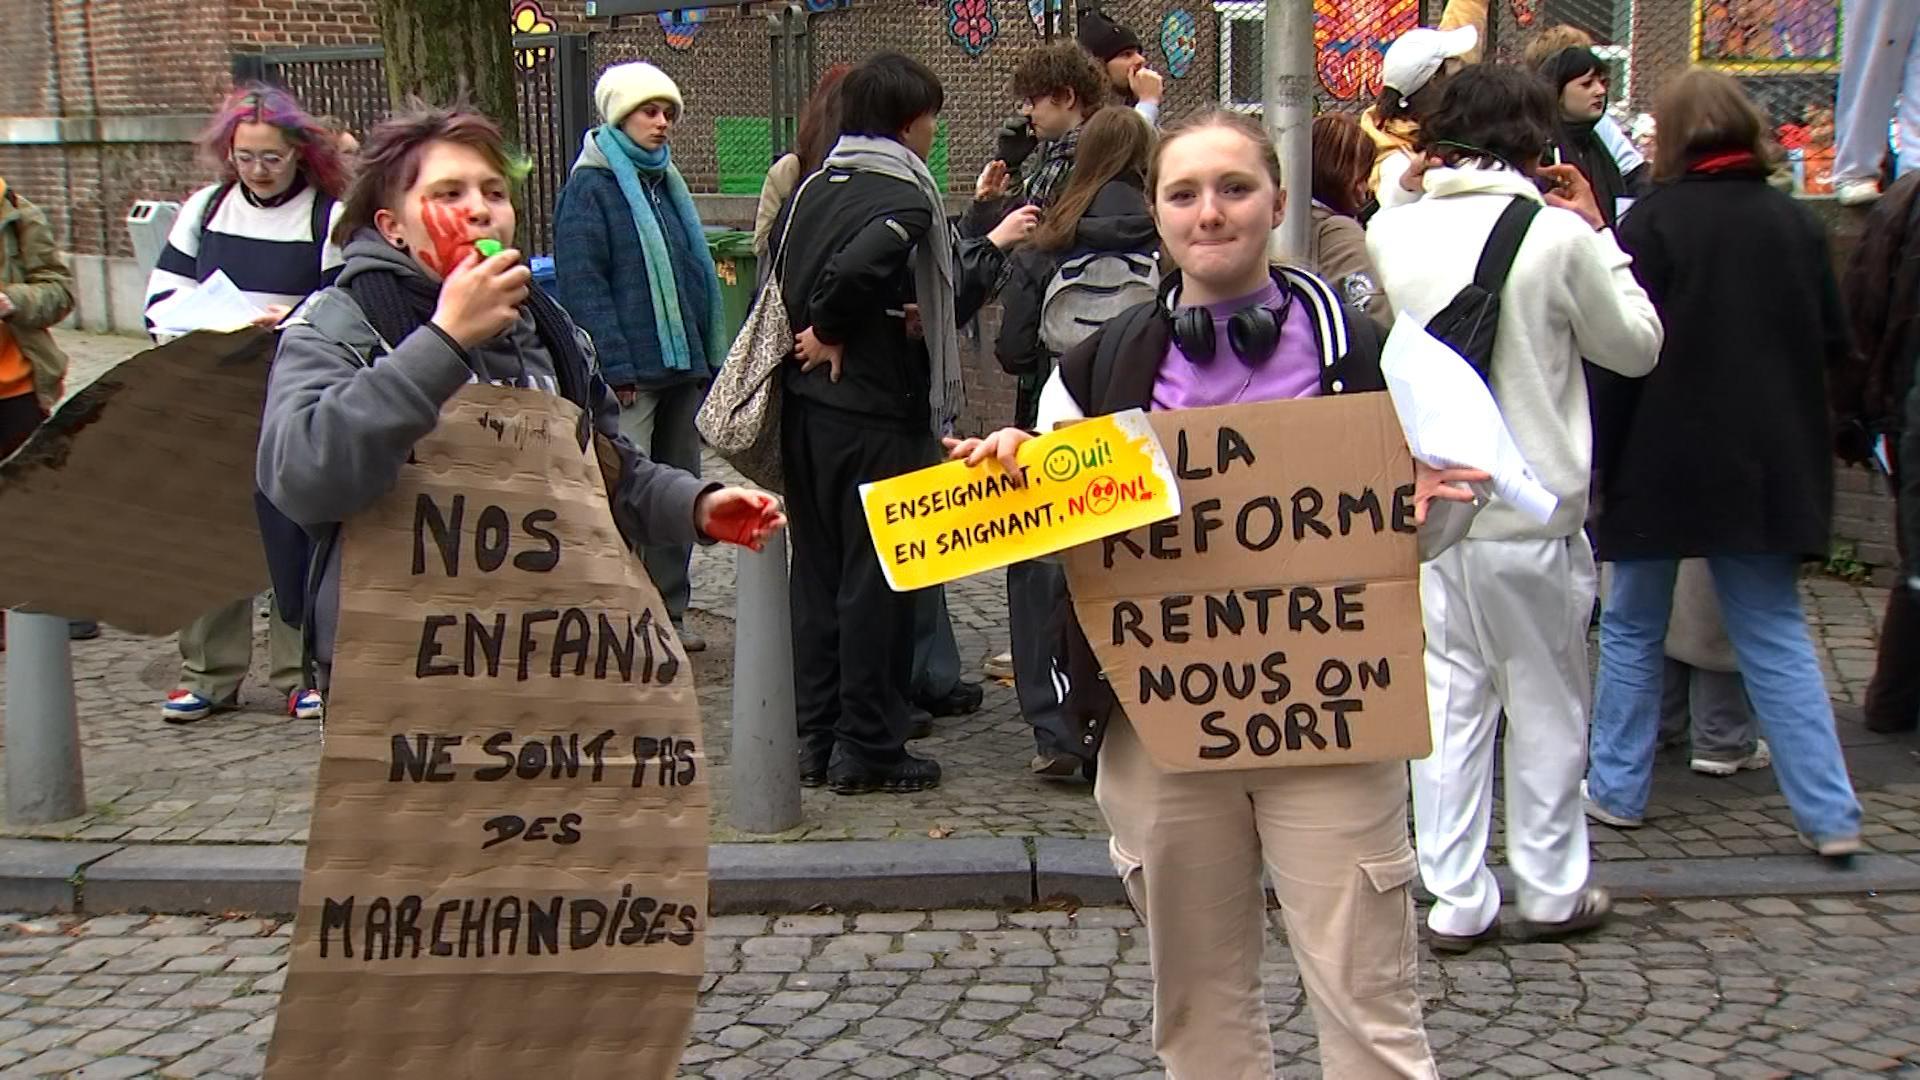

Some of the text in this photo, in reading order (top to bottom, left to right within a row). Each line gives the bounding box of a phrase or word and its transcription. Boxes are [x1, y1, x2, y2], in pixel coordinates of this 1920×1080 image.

[1177, 427, 1256, 480] LA
[411, 493, 561, 577] NOS
[895, 541, 926, 565] EN
[936, 503, 1065, 556] SAIGNANT,
[416, 607, 679, 684] ENFANTS
[1112, 584, 1366, 648] RENTRE
[1139, 652, 1391, 705] NOUS ON
[1198, 699, 1363, 758] SORT
[389, 729, 696, 788] NE SONT PAS
[481, 813, 582, 850] DES
